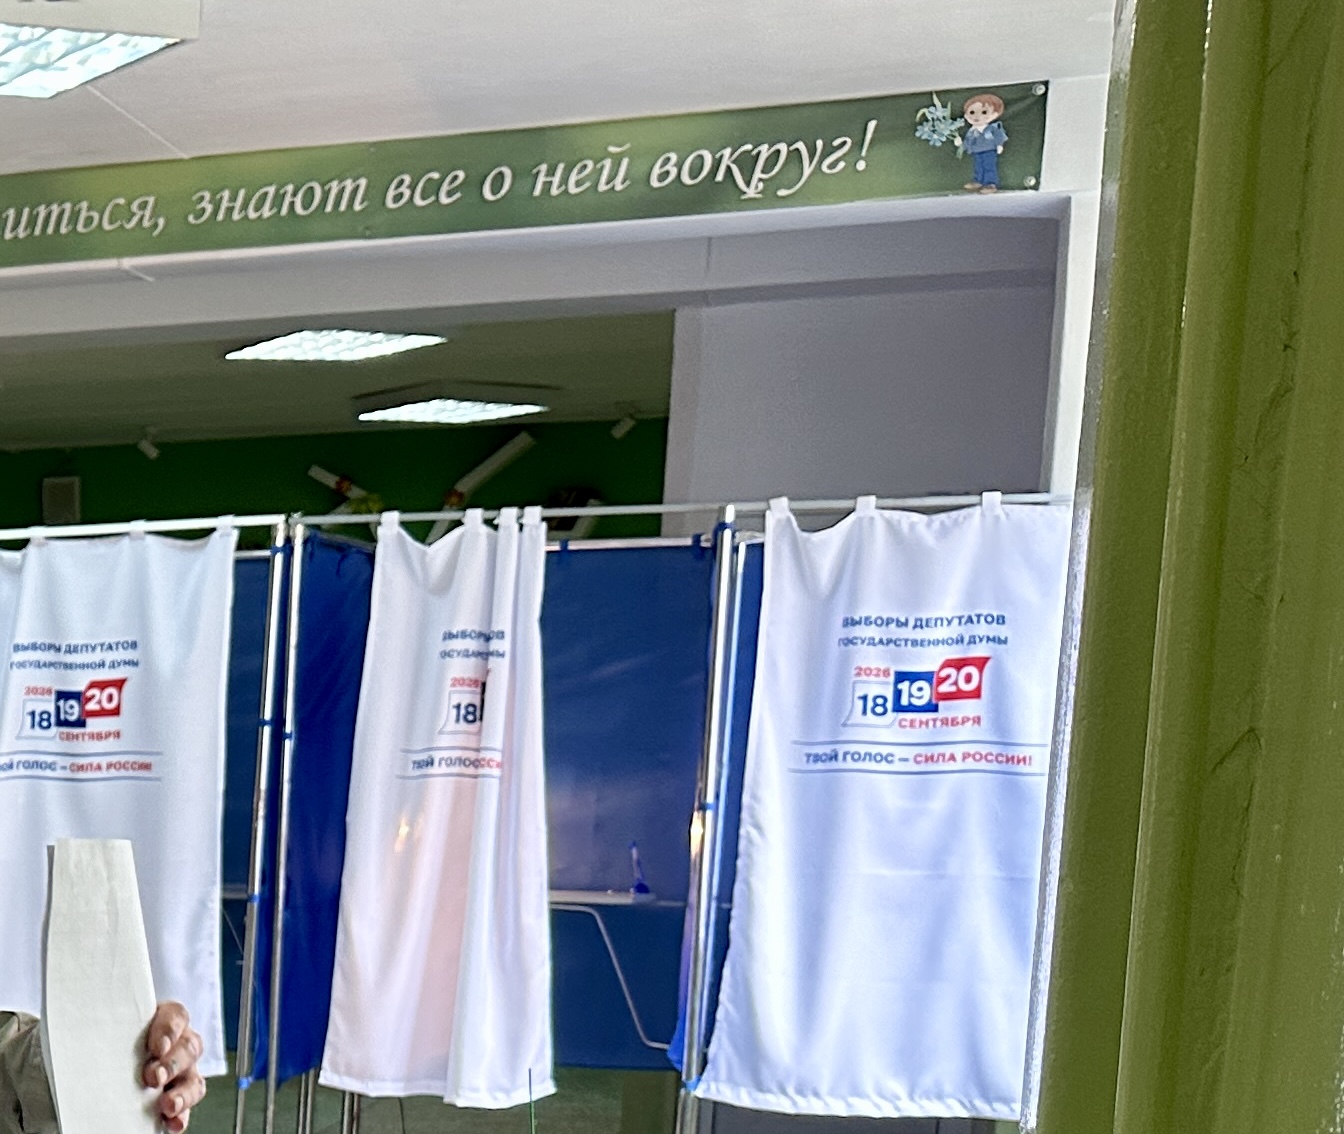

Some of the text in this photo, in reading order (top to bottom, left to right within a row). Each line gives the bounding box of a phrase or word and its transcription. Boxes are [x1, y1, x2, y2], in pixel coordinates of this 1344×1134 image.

[188, 177, 369, 226] знают
[385, 168, 463, 210] все
[483, 168, 513, 202] о
[531, 144, 632, 198] ней
[650, 120, 877, 200] вокруг!
[842, 613, 1006, 630] ВЫБОРЫ ДЕПУТАТОВ
[13, 640, 138, 655] ВЫБОРЫ ДЕПУТАТОВ
[838, 633, 1008, 648] ГОСУДАРСТВЕННОЙ ДУМЫ
[9, 659, 139, 671] ГОСУДАРСТВЕННОЙ ДУМЫ
[854, 666, 891, 678] 2026
[24, 686, 53, 696] 2026
[857, 665, 980, 716] 18 19 20
[27, 687, 120, 730] 18 19 20
[452, 702, 478, 724] 18
[898, 716, 982, 729] СЕНТЯБРЯ
[58, 730, 121, 742] СЕНТЯБРЯ
[805, 748, 838, 764] ТВОЙ
[843, 751, 895, 764] ГОЛОС
[913, 752, 957, 764] СИЛА
[962, 752, 1032, 767] РОССИИ!
[16, 760, 57, 772] ГОЛОС
[69, 762, 102, 773] СИЛА
